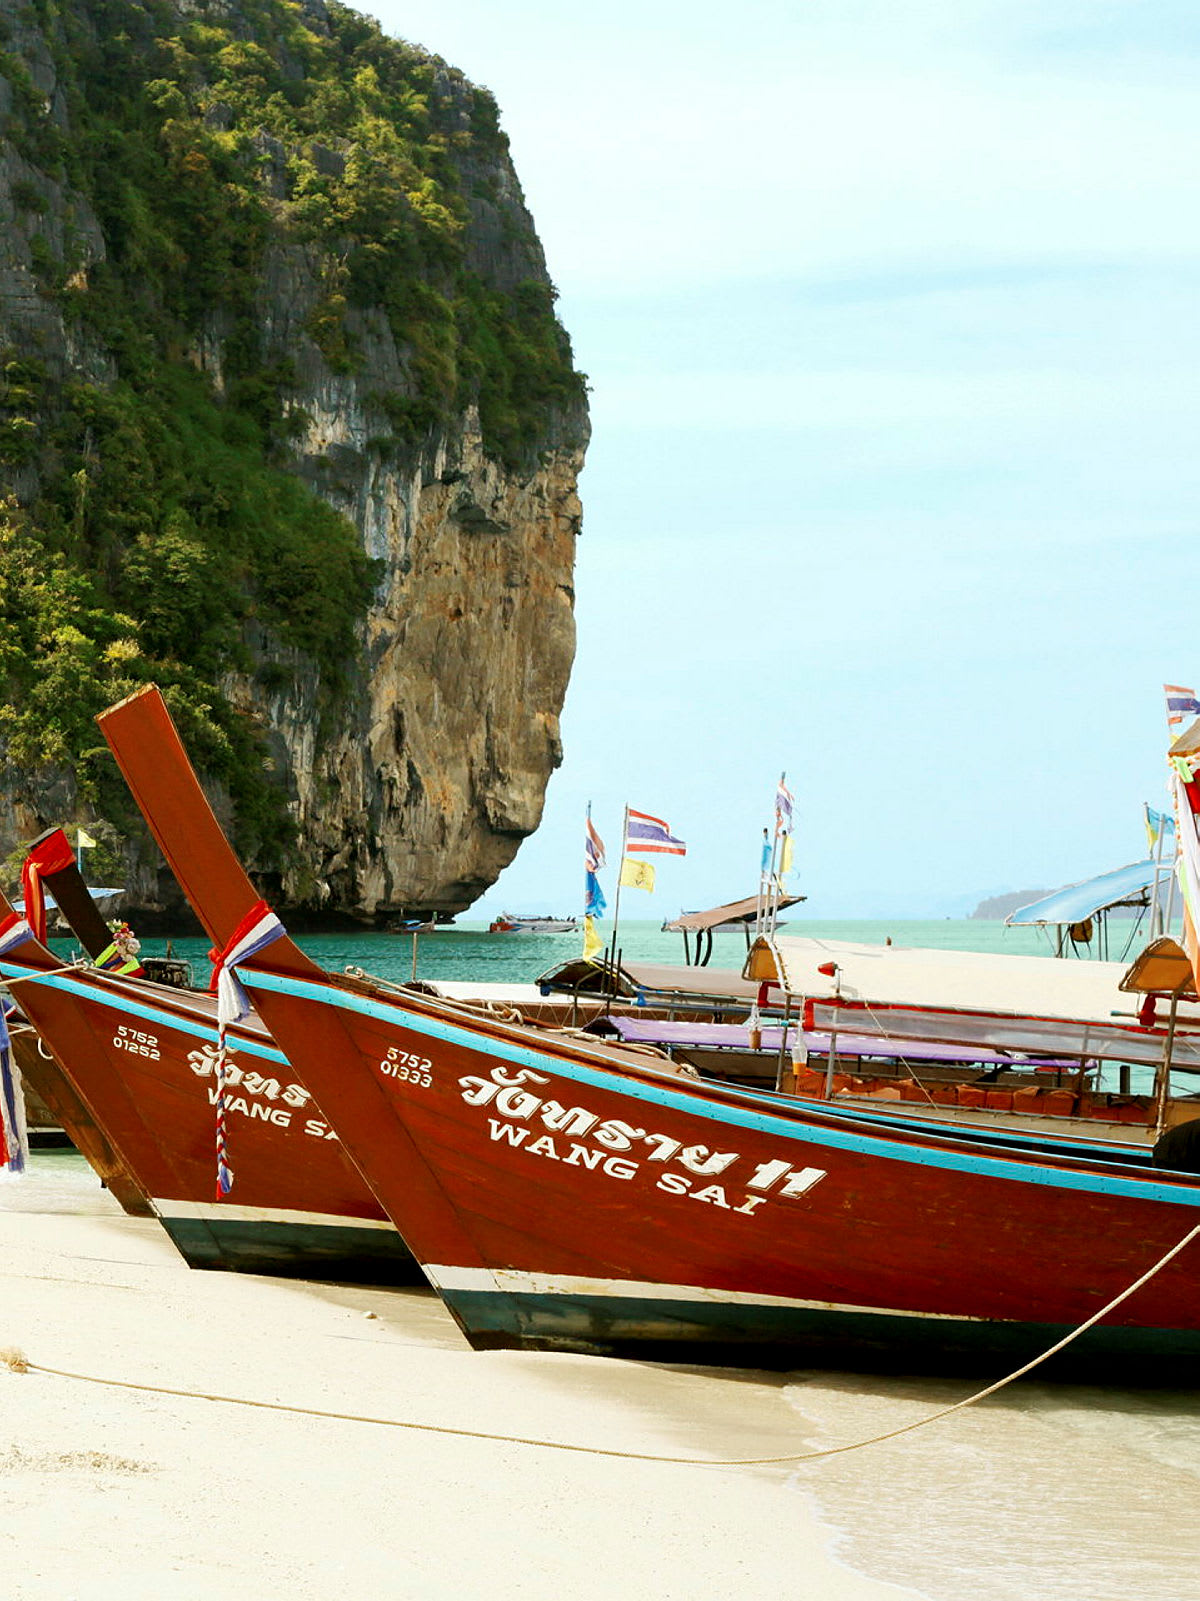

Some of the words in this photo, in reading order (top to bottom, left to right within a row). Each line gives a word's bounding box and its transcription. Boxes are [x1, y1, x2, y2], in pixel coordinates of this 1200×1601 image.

[113, 1037, 161, 1061] 01252
[117, 1025, 158, 1048] 5752
[387, 1046, 432, 1073] 5752
[380, 1060, 433, 1088] 01333
[207, 1087, 292, 1127] WANG
[487, 1118, 640, 1180] WANG
[656, 1172, 768, 1216] SAI
[745, 1159, 829, 1200] 11
